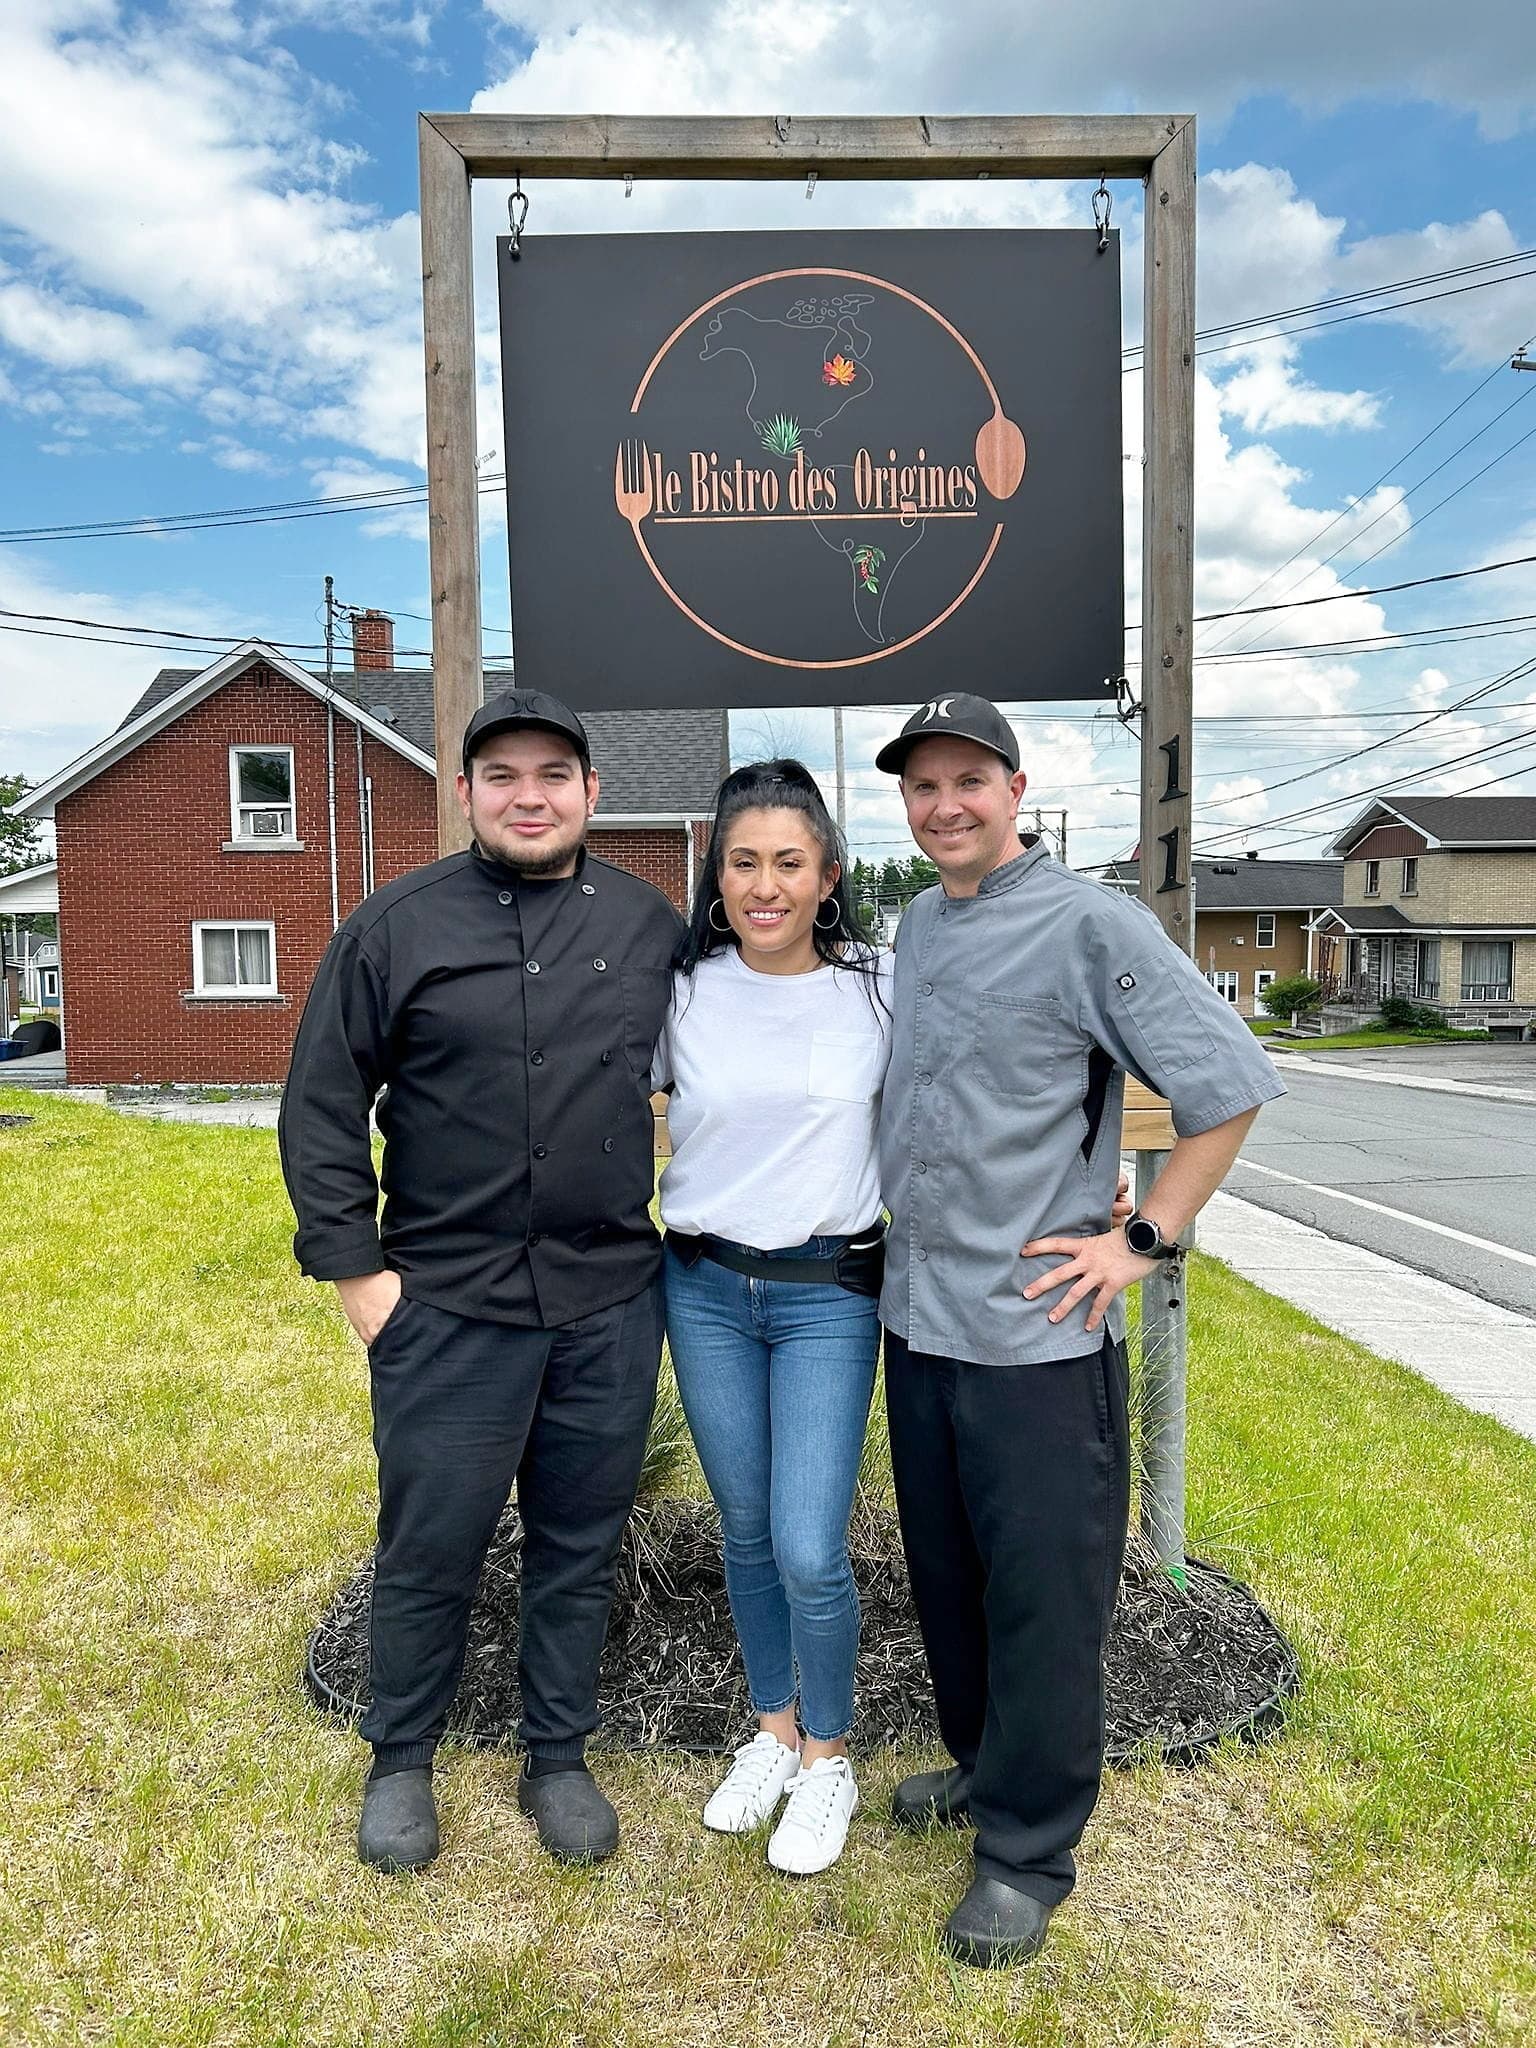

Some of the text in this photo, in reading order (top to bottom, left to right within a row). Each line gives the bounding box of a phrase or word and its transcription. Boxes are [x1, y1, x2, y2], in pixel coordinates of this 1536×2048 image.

[653, 447, 978, 528] le Bistro des Origines
